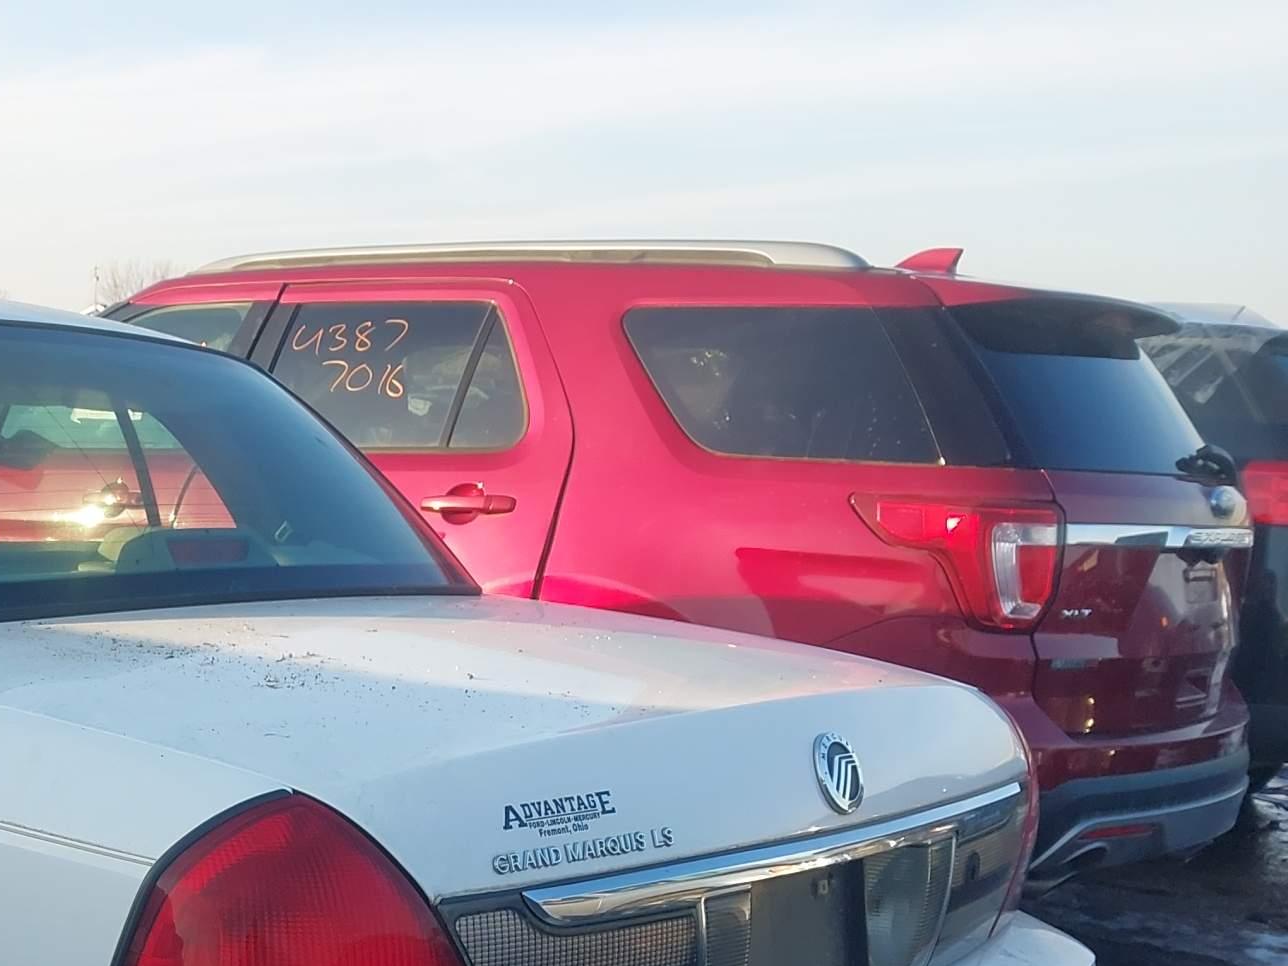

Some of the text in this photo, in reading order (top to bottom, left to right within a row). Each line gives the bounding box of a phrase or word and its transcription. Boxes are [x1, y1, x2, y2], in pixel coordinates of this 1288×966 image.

[292, 318, 409, 356] 4387
[321, 360, 404, 398] 7016
[503, 790, 617, 831] ADVANTAGE
[538, 822, 589, 838] Fremont, Ohio
[492, 827, 675, 875] GRAND MARQUIS LS
